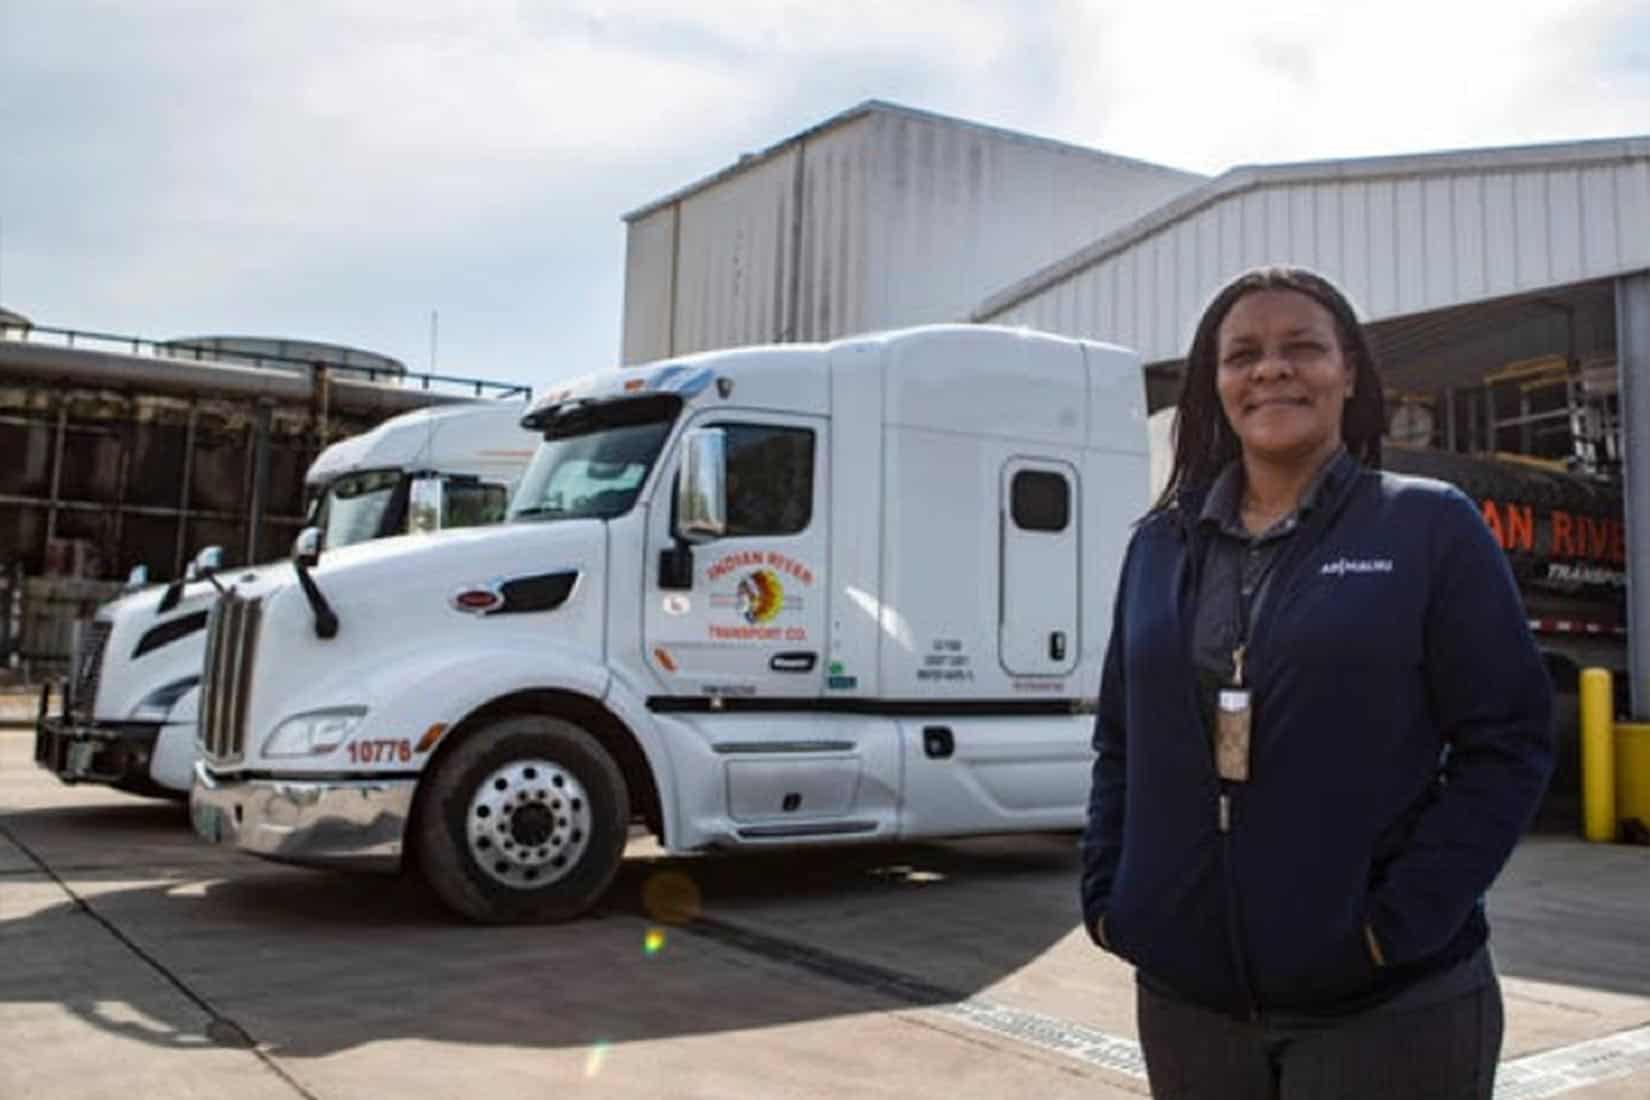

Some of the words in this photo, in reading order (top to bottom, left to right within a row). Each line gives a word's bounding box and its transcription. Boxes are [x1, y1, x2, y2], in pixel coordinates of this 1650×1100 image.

[706, 552, 762, 580] INDIAN
[768, 552, 814, 586] RIVER
[709, 625, 782, 639] TRANSPORT
